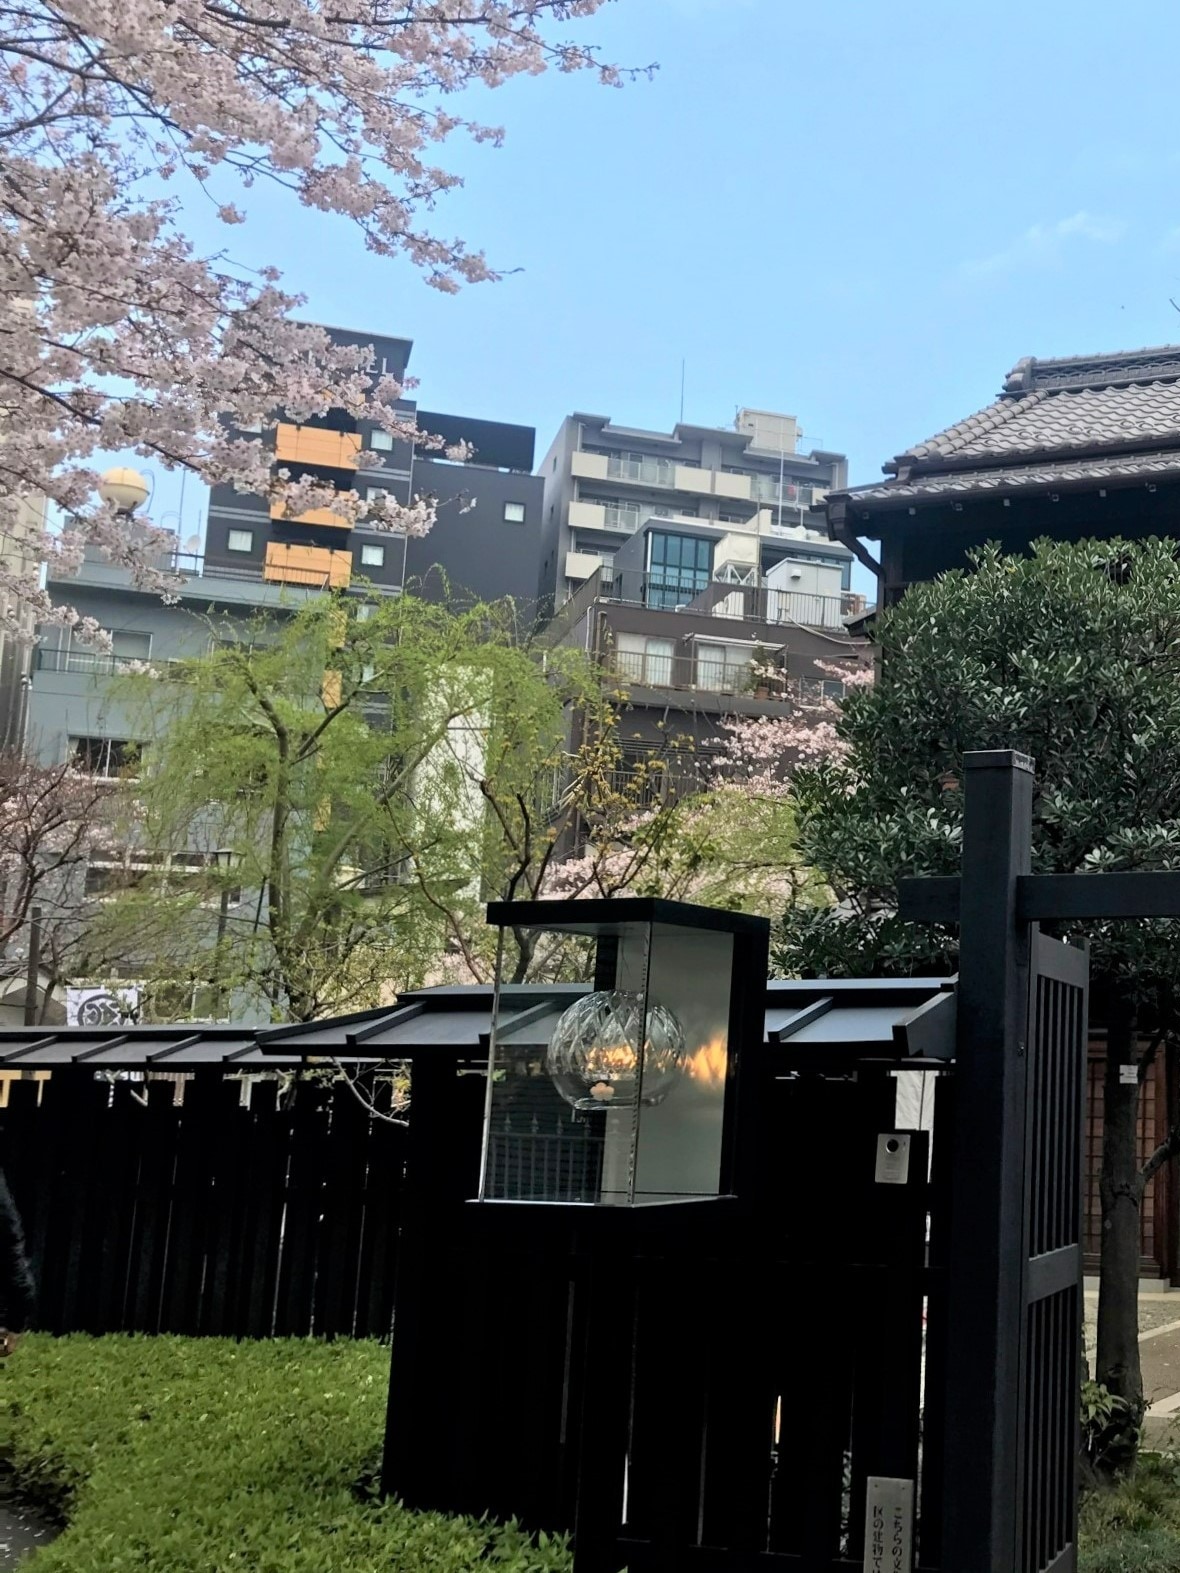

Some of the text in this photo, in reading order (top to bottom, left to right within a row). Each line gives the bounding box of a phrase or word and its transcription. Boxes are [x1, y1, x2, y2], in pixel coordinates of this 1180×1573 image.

[892, 1507, 903, 1573] こちらの文
